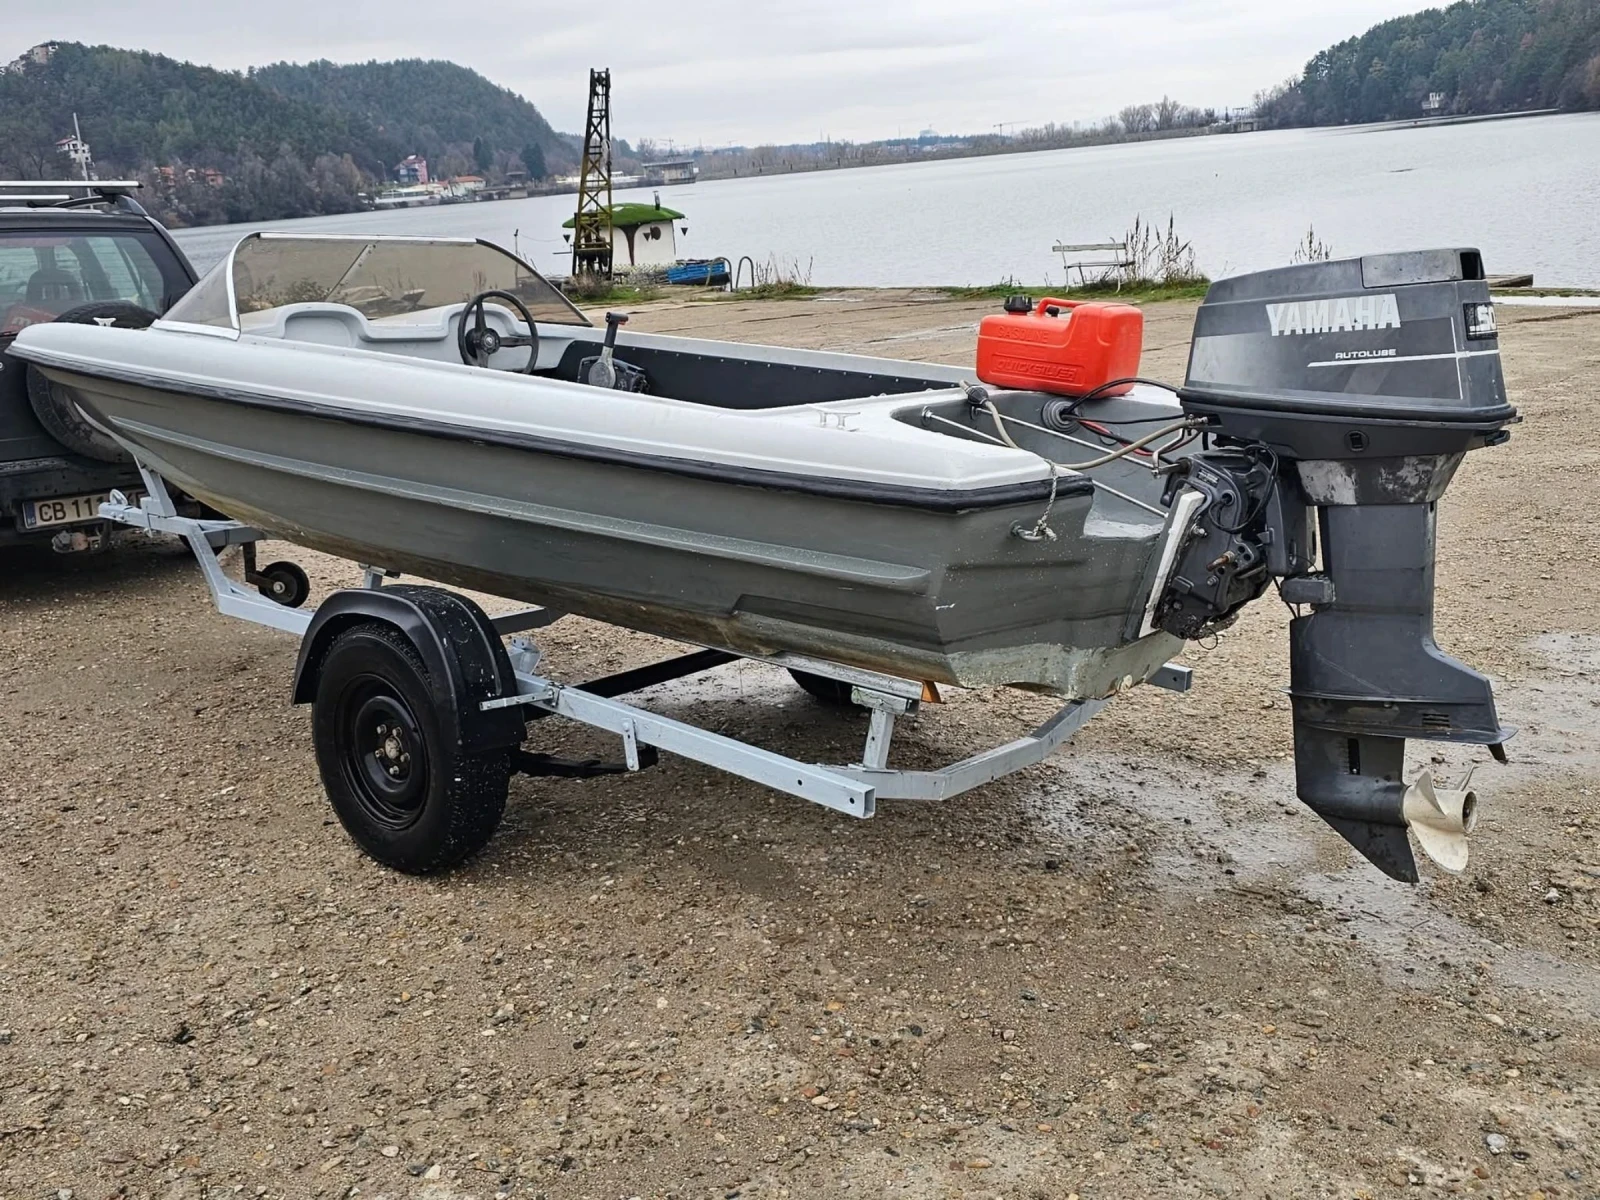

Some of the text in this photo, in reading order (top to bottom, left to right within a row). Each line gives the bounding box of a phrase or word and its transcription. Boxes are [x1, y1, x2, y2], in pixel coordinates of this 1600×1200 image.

[1265, 293, 1401, 336] YAMAHA
[997, 323, 1050, 343] GASOLINE
[1335, 348, 1397, 360] AUTOLUBE
[995, 359, 1078, 382] QUICKSILVER
[39, 502, 66, 522] CB
